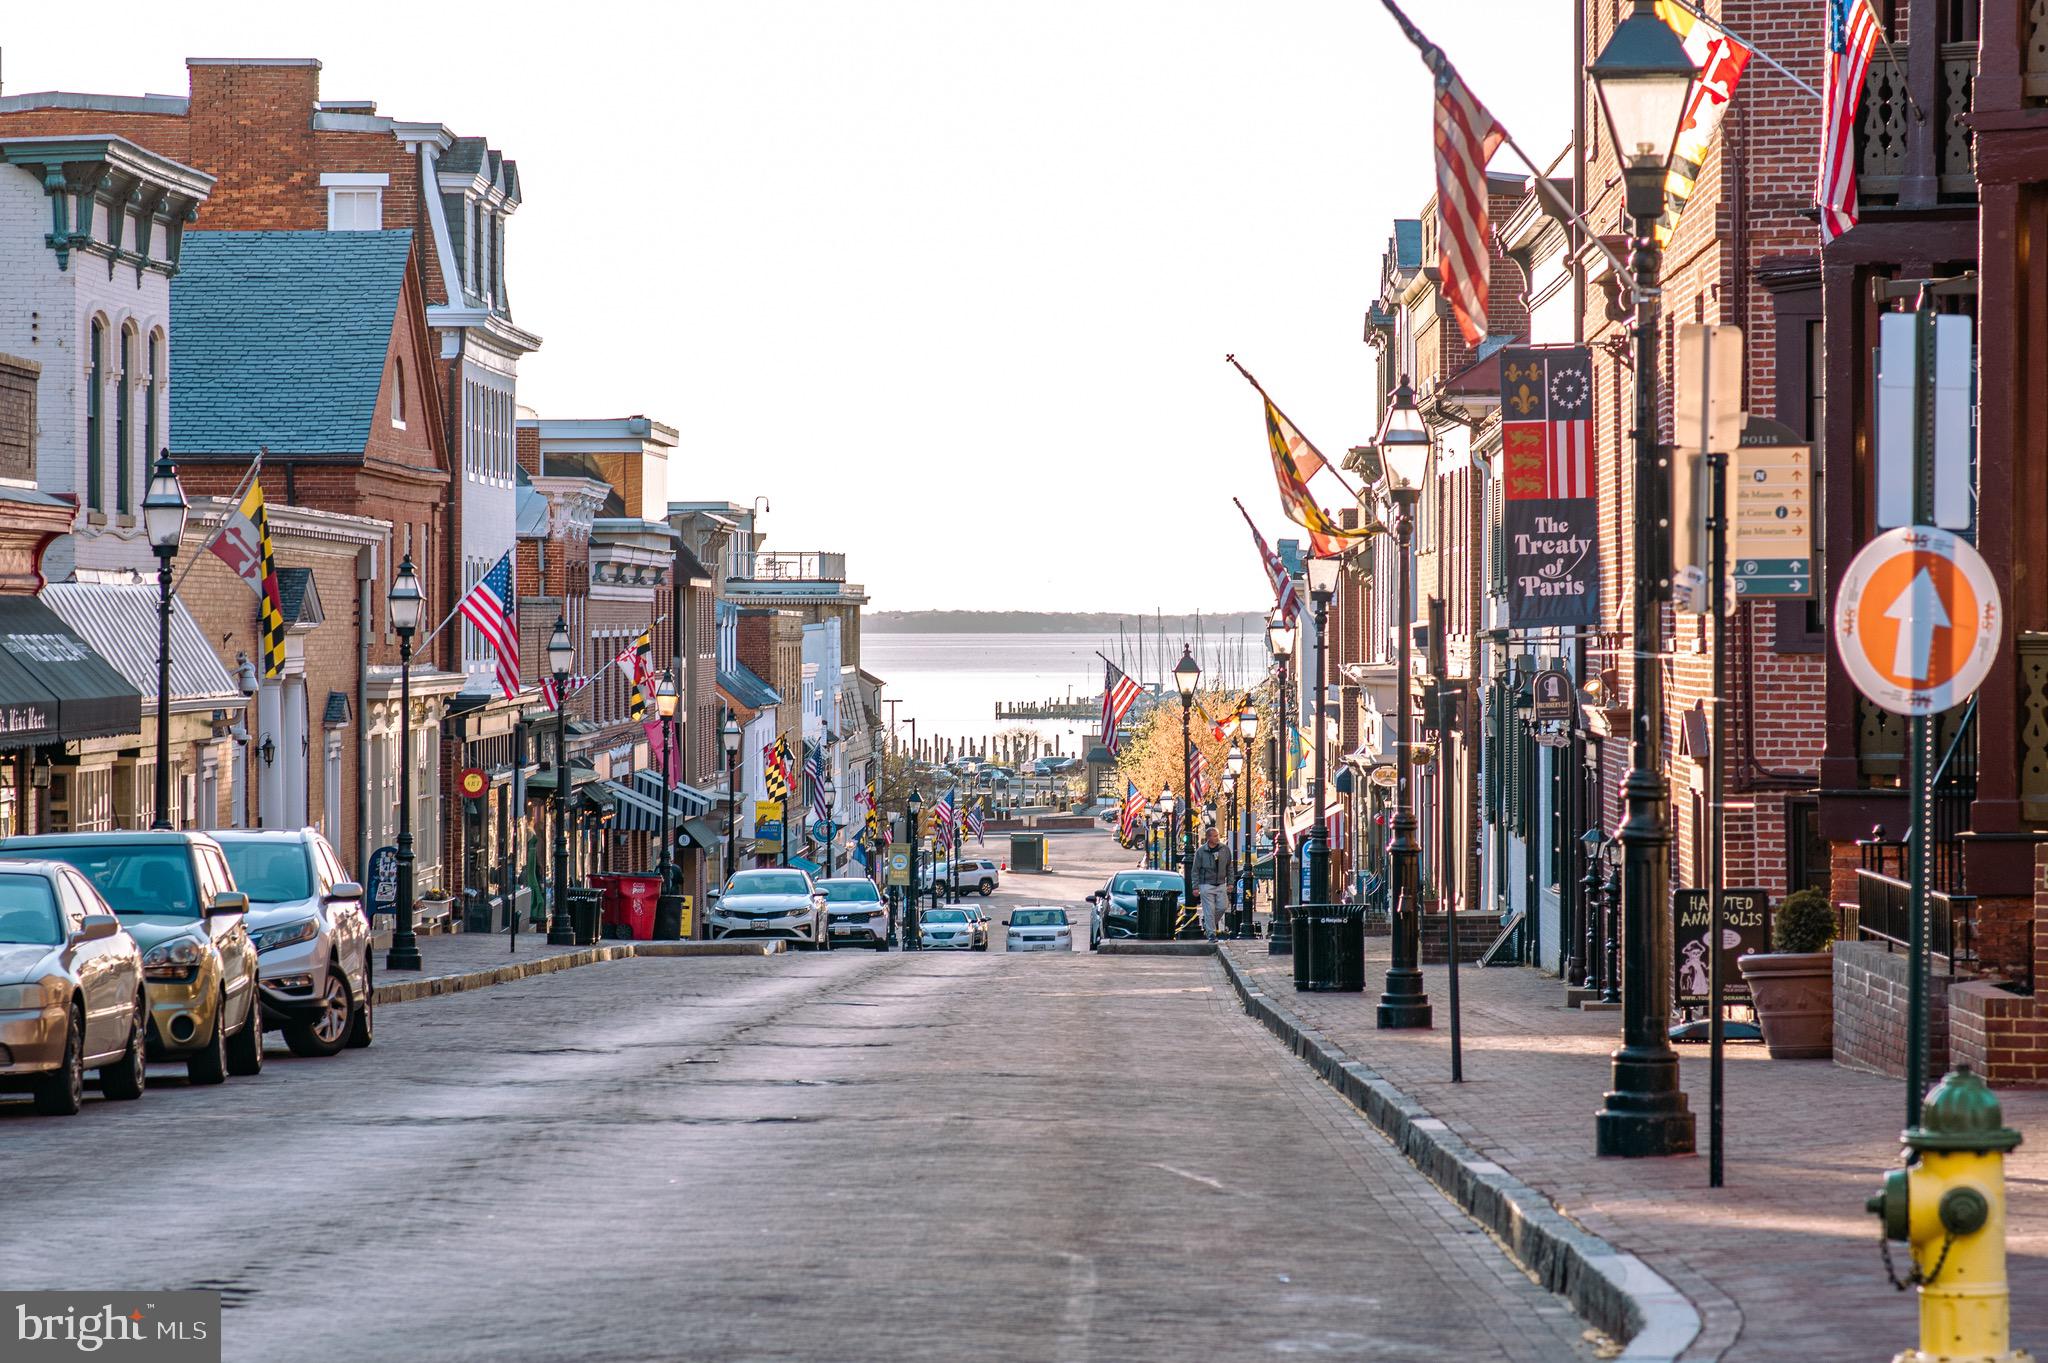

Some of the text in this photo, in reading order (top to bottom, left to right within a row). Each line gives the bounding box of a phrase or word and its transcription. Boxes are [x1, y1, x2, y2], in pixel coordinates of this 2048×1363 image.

[1742, 435, 1779, 444] POLIS
[1535, 517, 1569, 533] The
[1515, 534, 1592, 562] Treaty
[1542, 558, 1564, 577] of
[1518, 574, 1585, 597] Paris
[9, 708, 26, 732] Mini
[28, 706, 45, 730] Mart
[1689, 896, 1754, 911] HATED
